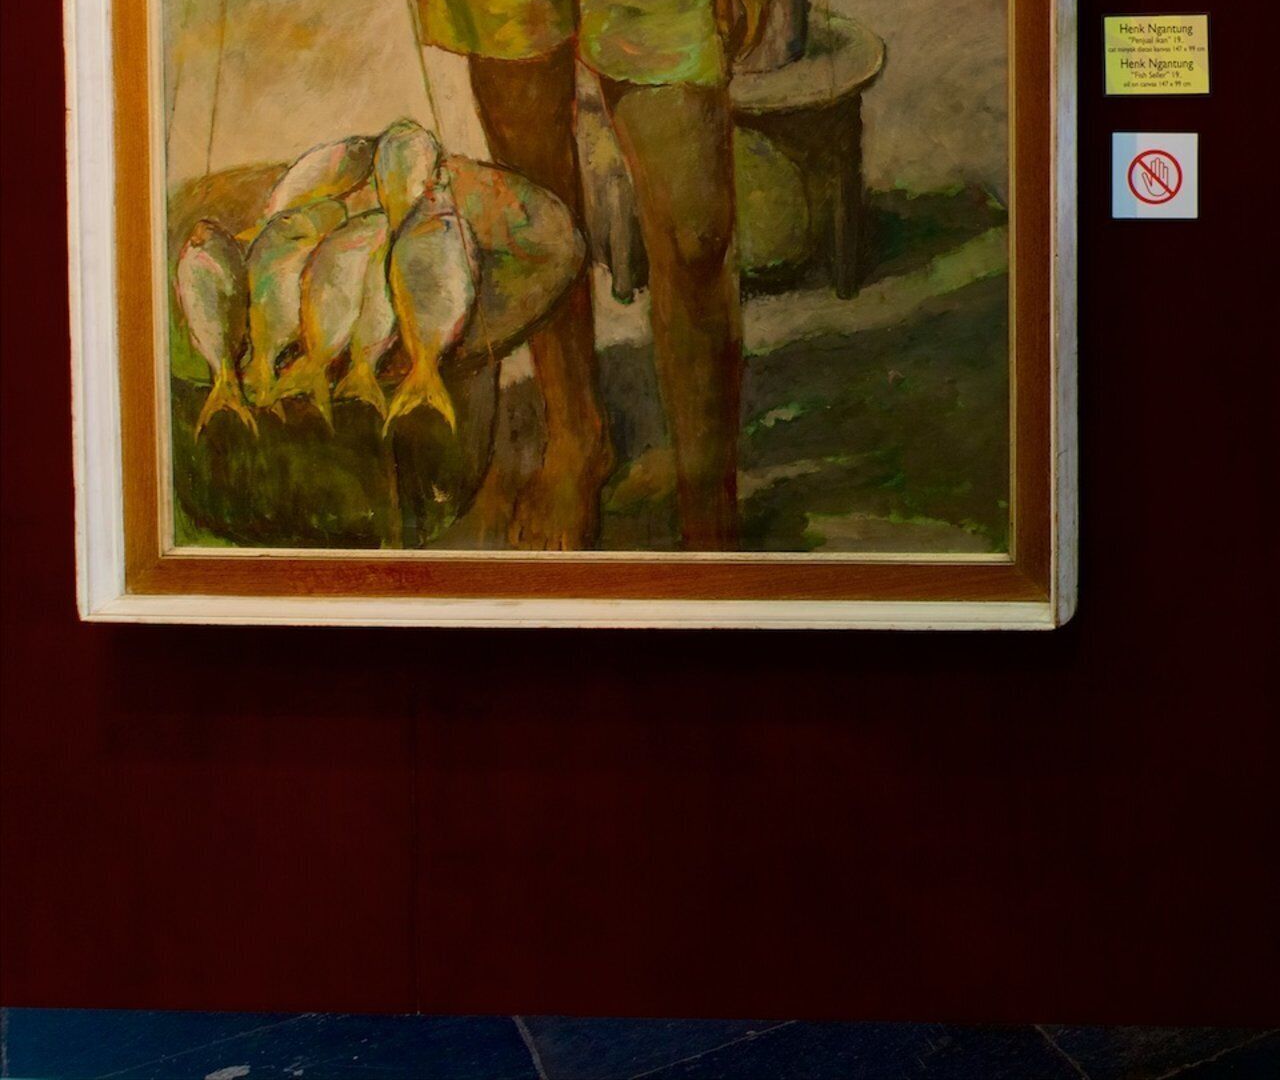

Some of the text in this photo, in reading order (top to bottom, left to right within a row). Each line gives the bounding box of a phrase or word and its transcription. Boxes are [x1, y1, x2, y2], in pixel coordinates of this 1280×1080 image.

[1120, 23, 1193, 37] Henk Ngantung
[1120, 58, 1194, 71] Henk Ngantung
